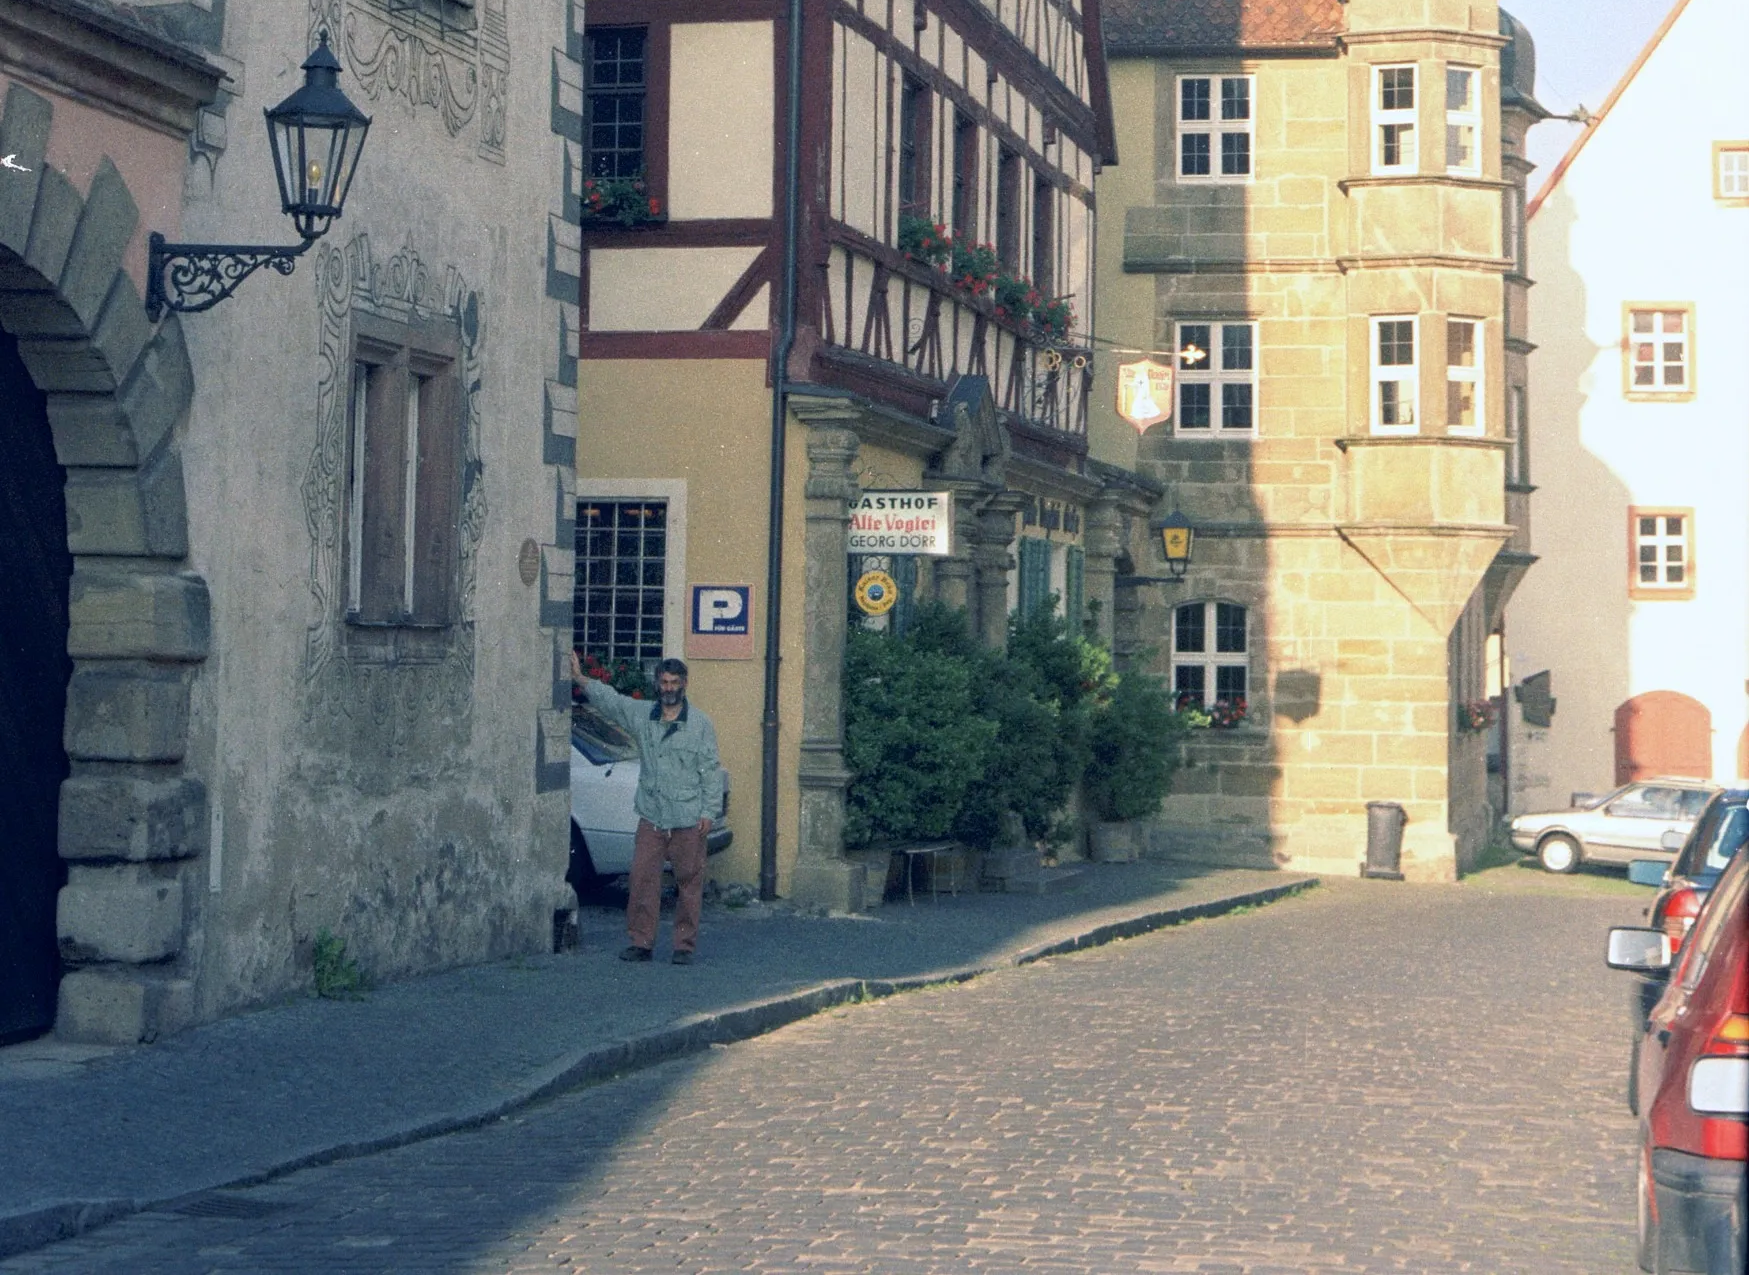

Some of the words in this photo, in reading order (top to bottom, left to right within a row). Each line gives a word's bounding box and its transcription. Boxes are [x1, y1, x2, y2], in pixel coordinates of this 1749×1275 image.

[848, 513, 882, 531] Alte
[850, 535, 896, 548] GEORG
[900, 533, 937, 548] DÖRR
[699, 589, 743, 631] P
